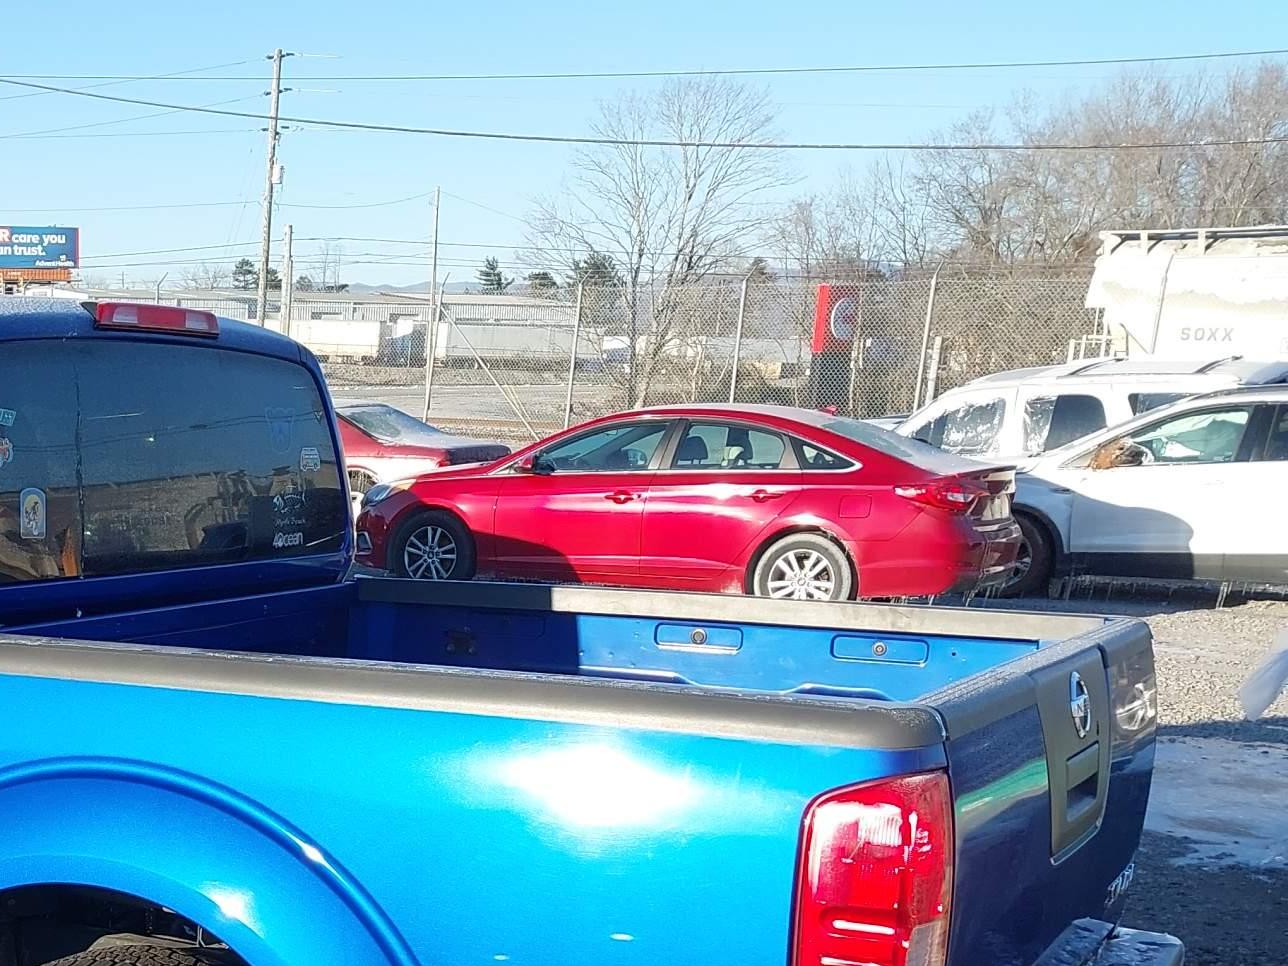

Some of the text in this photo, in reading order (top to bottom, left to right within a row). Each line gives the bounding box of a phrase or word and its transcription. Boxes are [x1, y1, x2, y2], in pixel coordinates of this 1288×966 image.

[12, 233, 40, 243] care
[43, 233, 66, 246] you
[13, 245, 46, 256] trust.
[1180, 327, 1234, 342] SOXX
